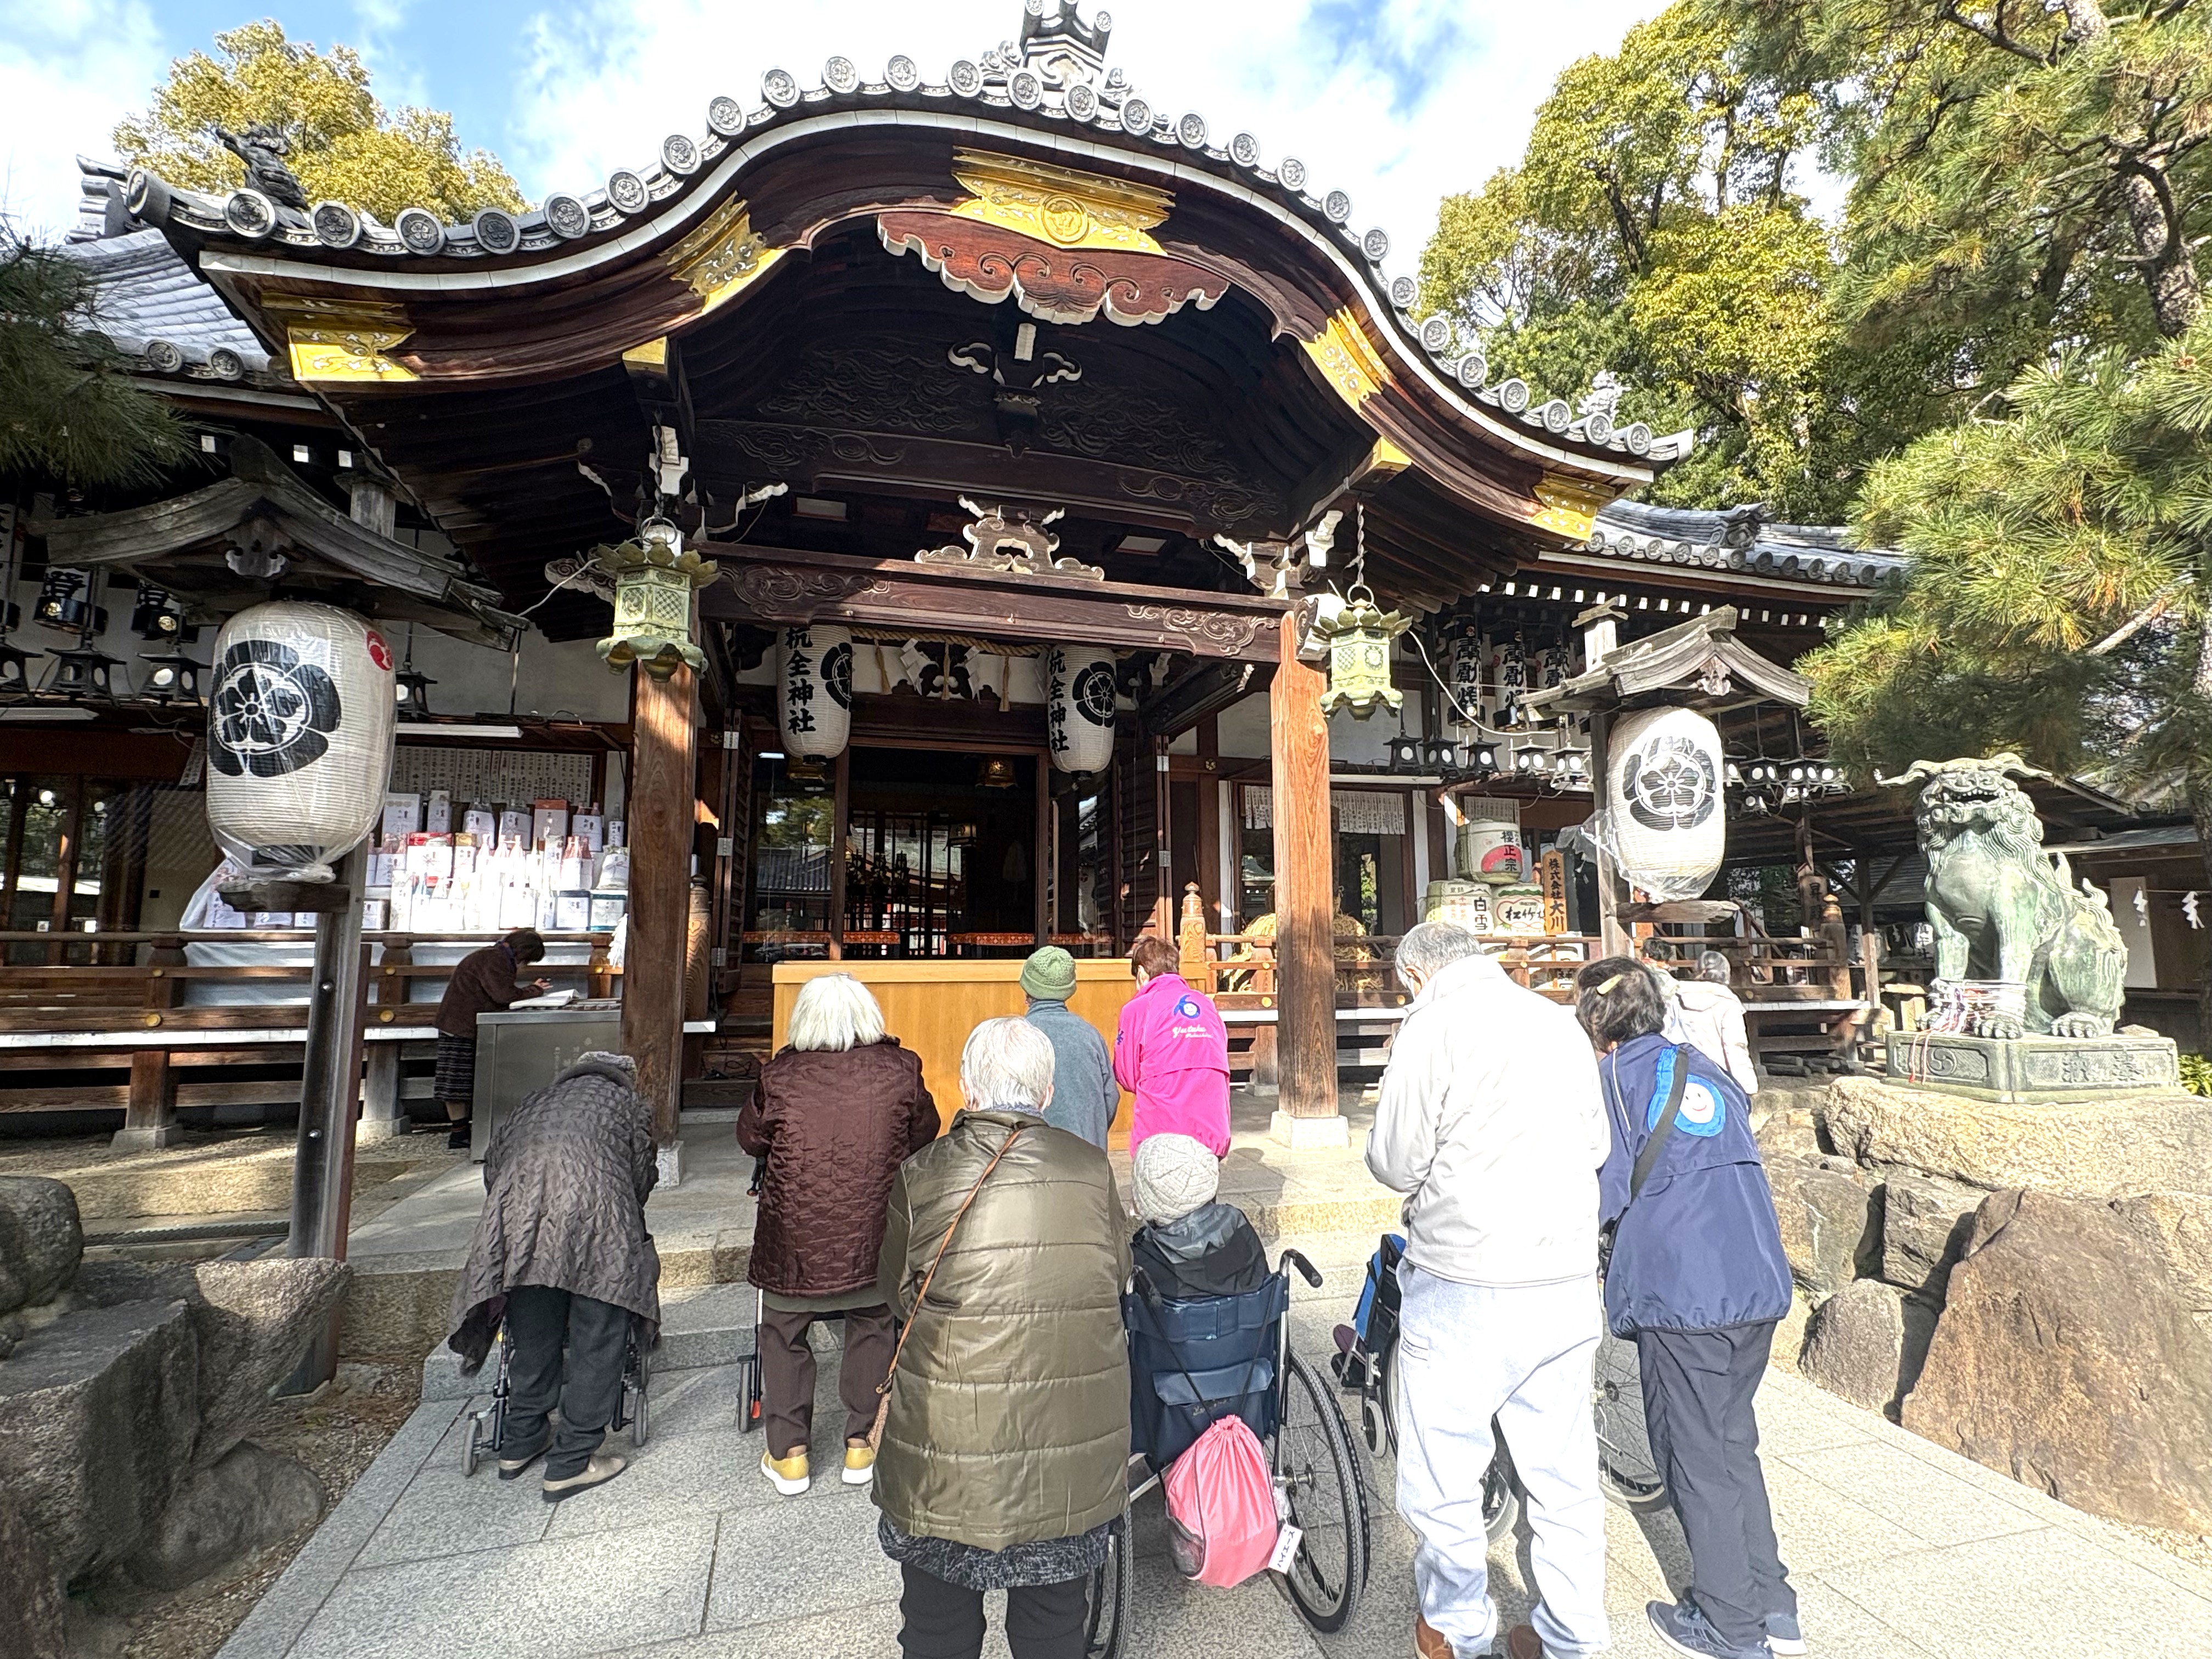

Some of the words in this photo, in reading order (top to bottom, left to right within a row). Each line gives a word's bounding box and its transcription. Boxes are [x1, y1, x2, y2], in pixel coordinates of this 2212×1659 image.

[785, 627, 816, 735] 杭全神社
[1048, 650, 1070, 754] 杭全神社
[1474, 896, 1488, 930] 白雪
